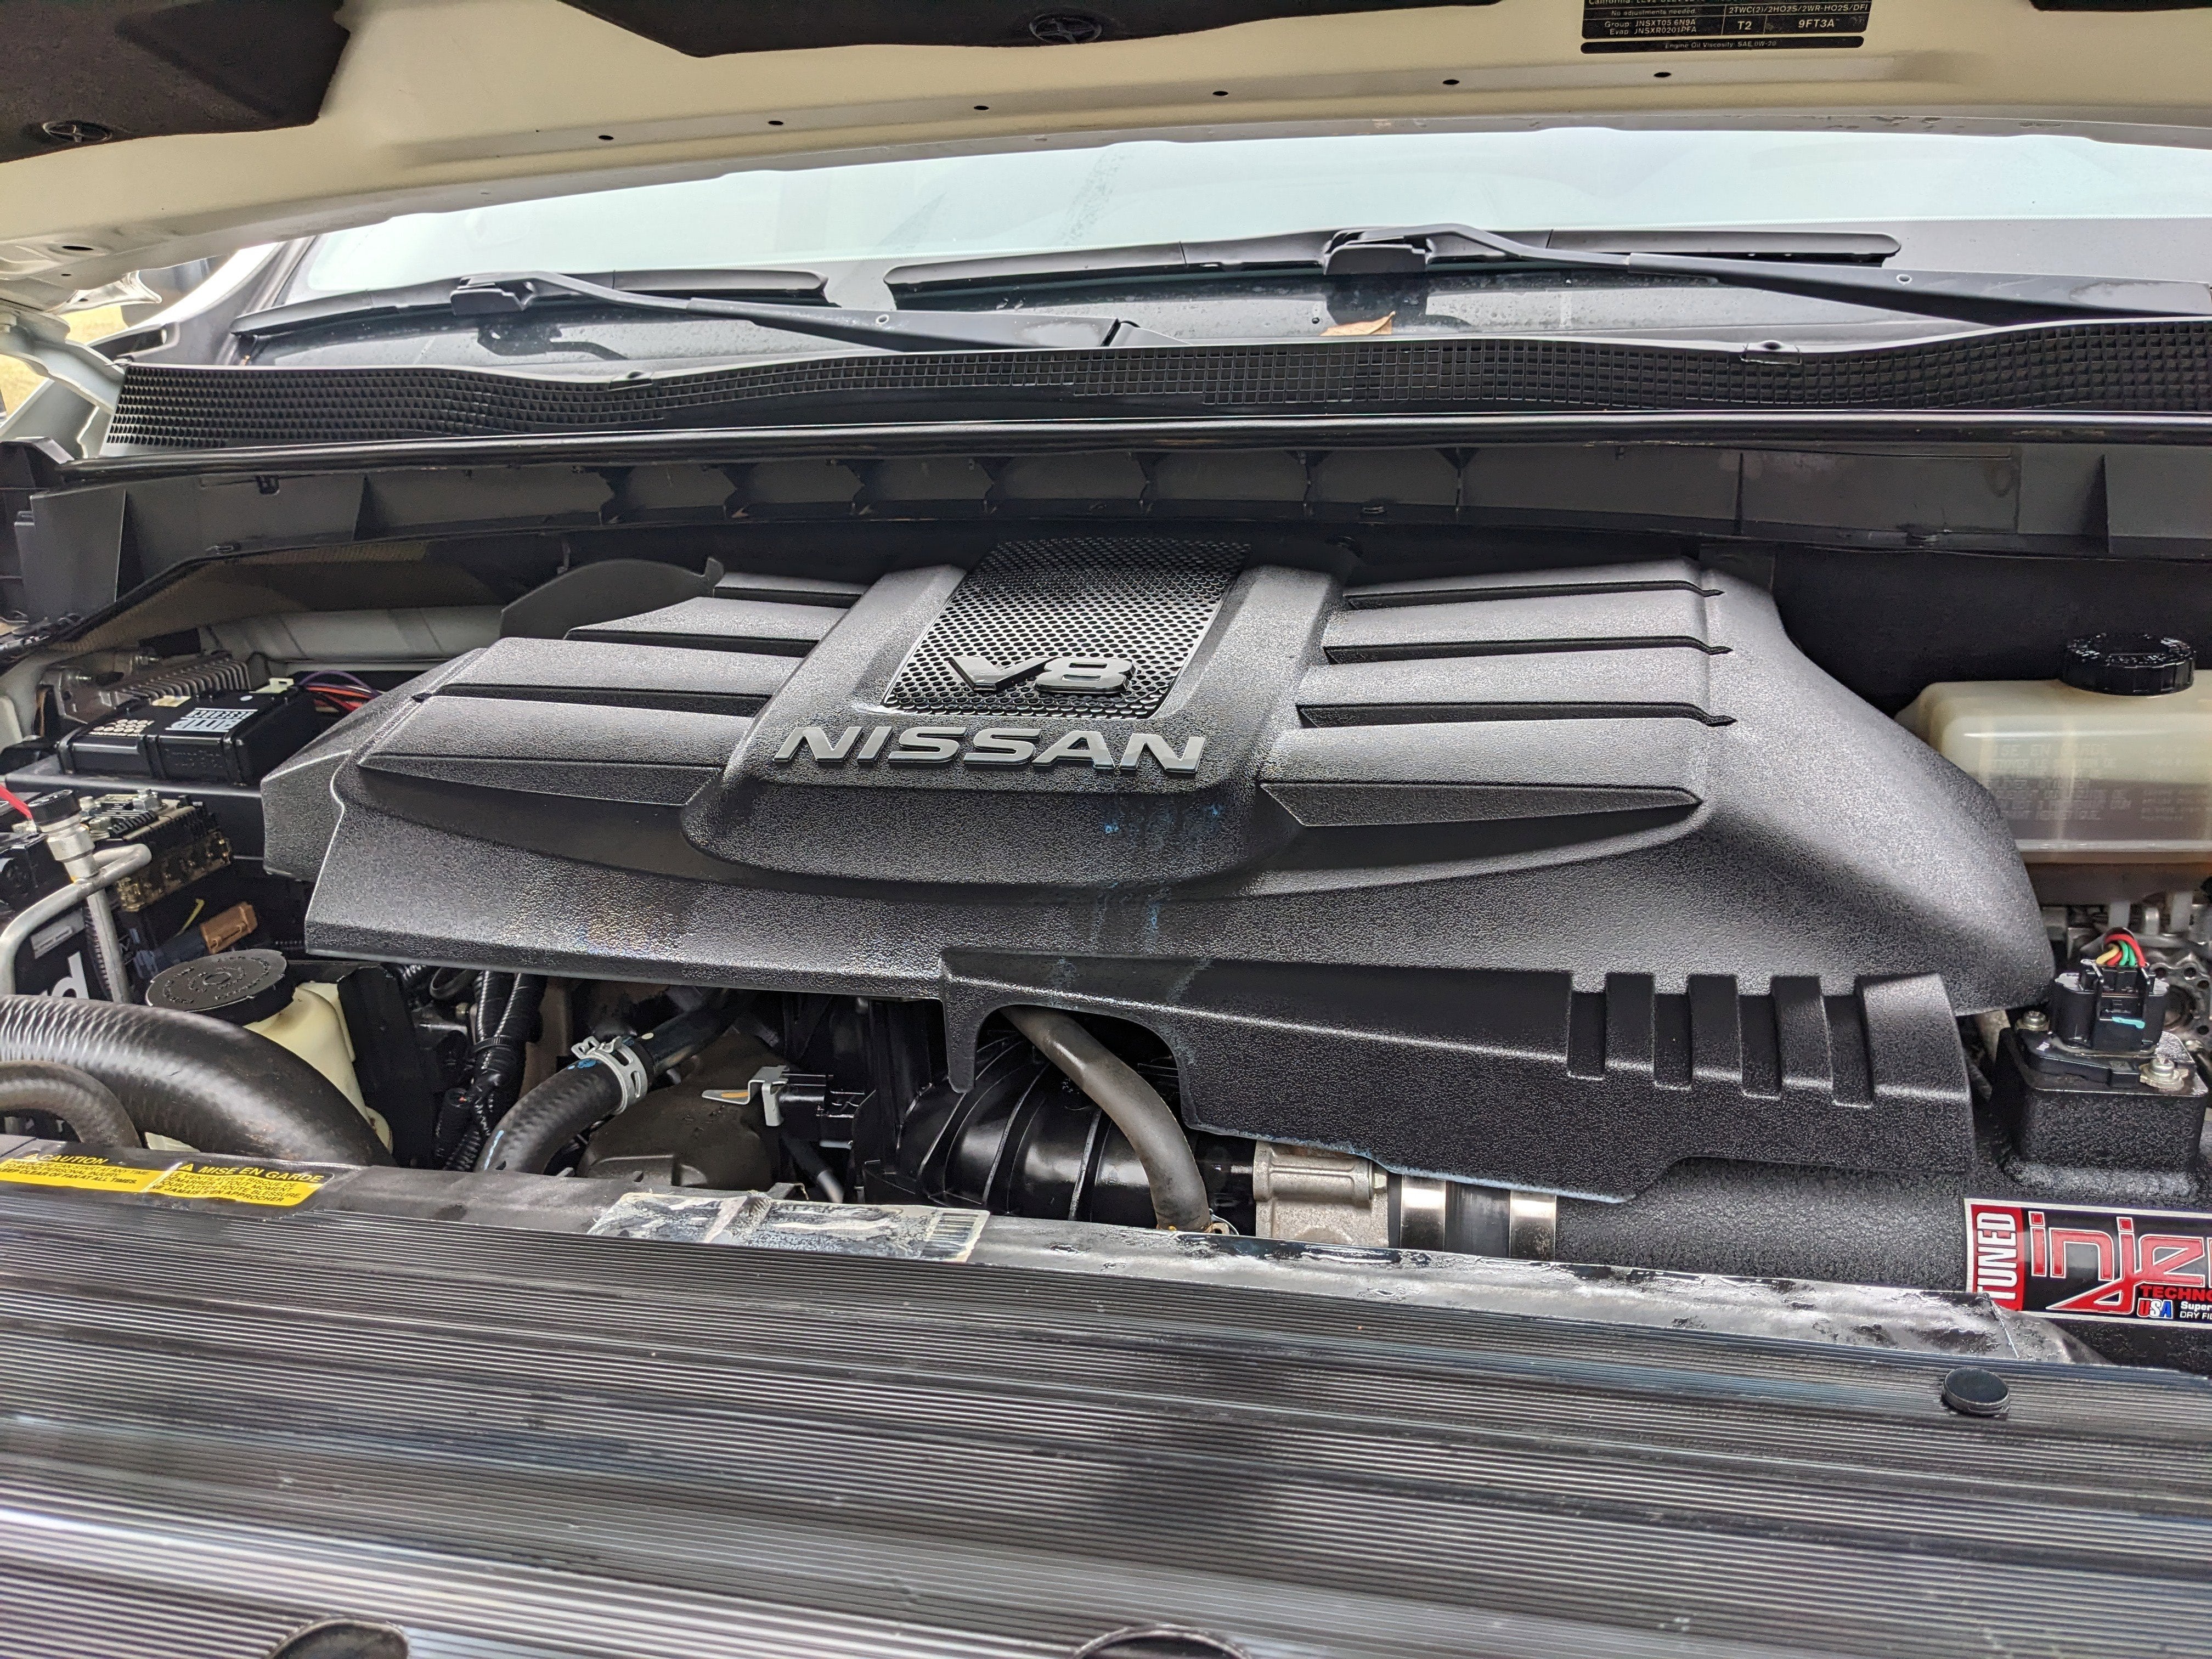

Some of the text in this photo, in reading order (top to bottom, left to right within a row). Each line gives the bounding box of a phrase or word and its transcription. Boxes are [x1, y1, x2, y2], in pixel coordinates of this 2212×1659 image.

[1737, 21, 1752, 30] T2
[1798, 19, 1835, 28] 9FT3A
[947, 658, 1137, 695] V8
[773, 726, 1206, 774] NISSAN
[40, 1154, 109, 1164] CAUTION
[198, 1166, 325, 1182] MISE EN GARDE
[159, 1181, 184, 1189] OUR
[248, 1177, 283, 1186] RISQUE
[224, 1190, 285, 1202] APPROCHER
[1977, 1212, 2018, 1300] TUNED
[2028, 1211, 2212, 1315] inje
[2137, 1297, 2173, 1319] USA
[2180, 1301, 2212, 1312] Super
[2180, 1310, 2200, 1319] DRY
